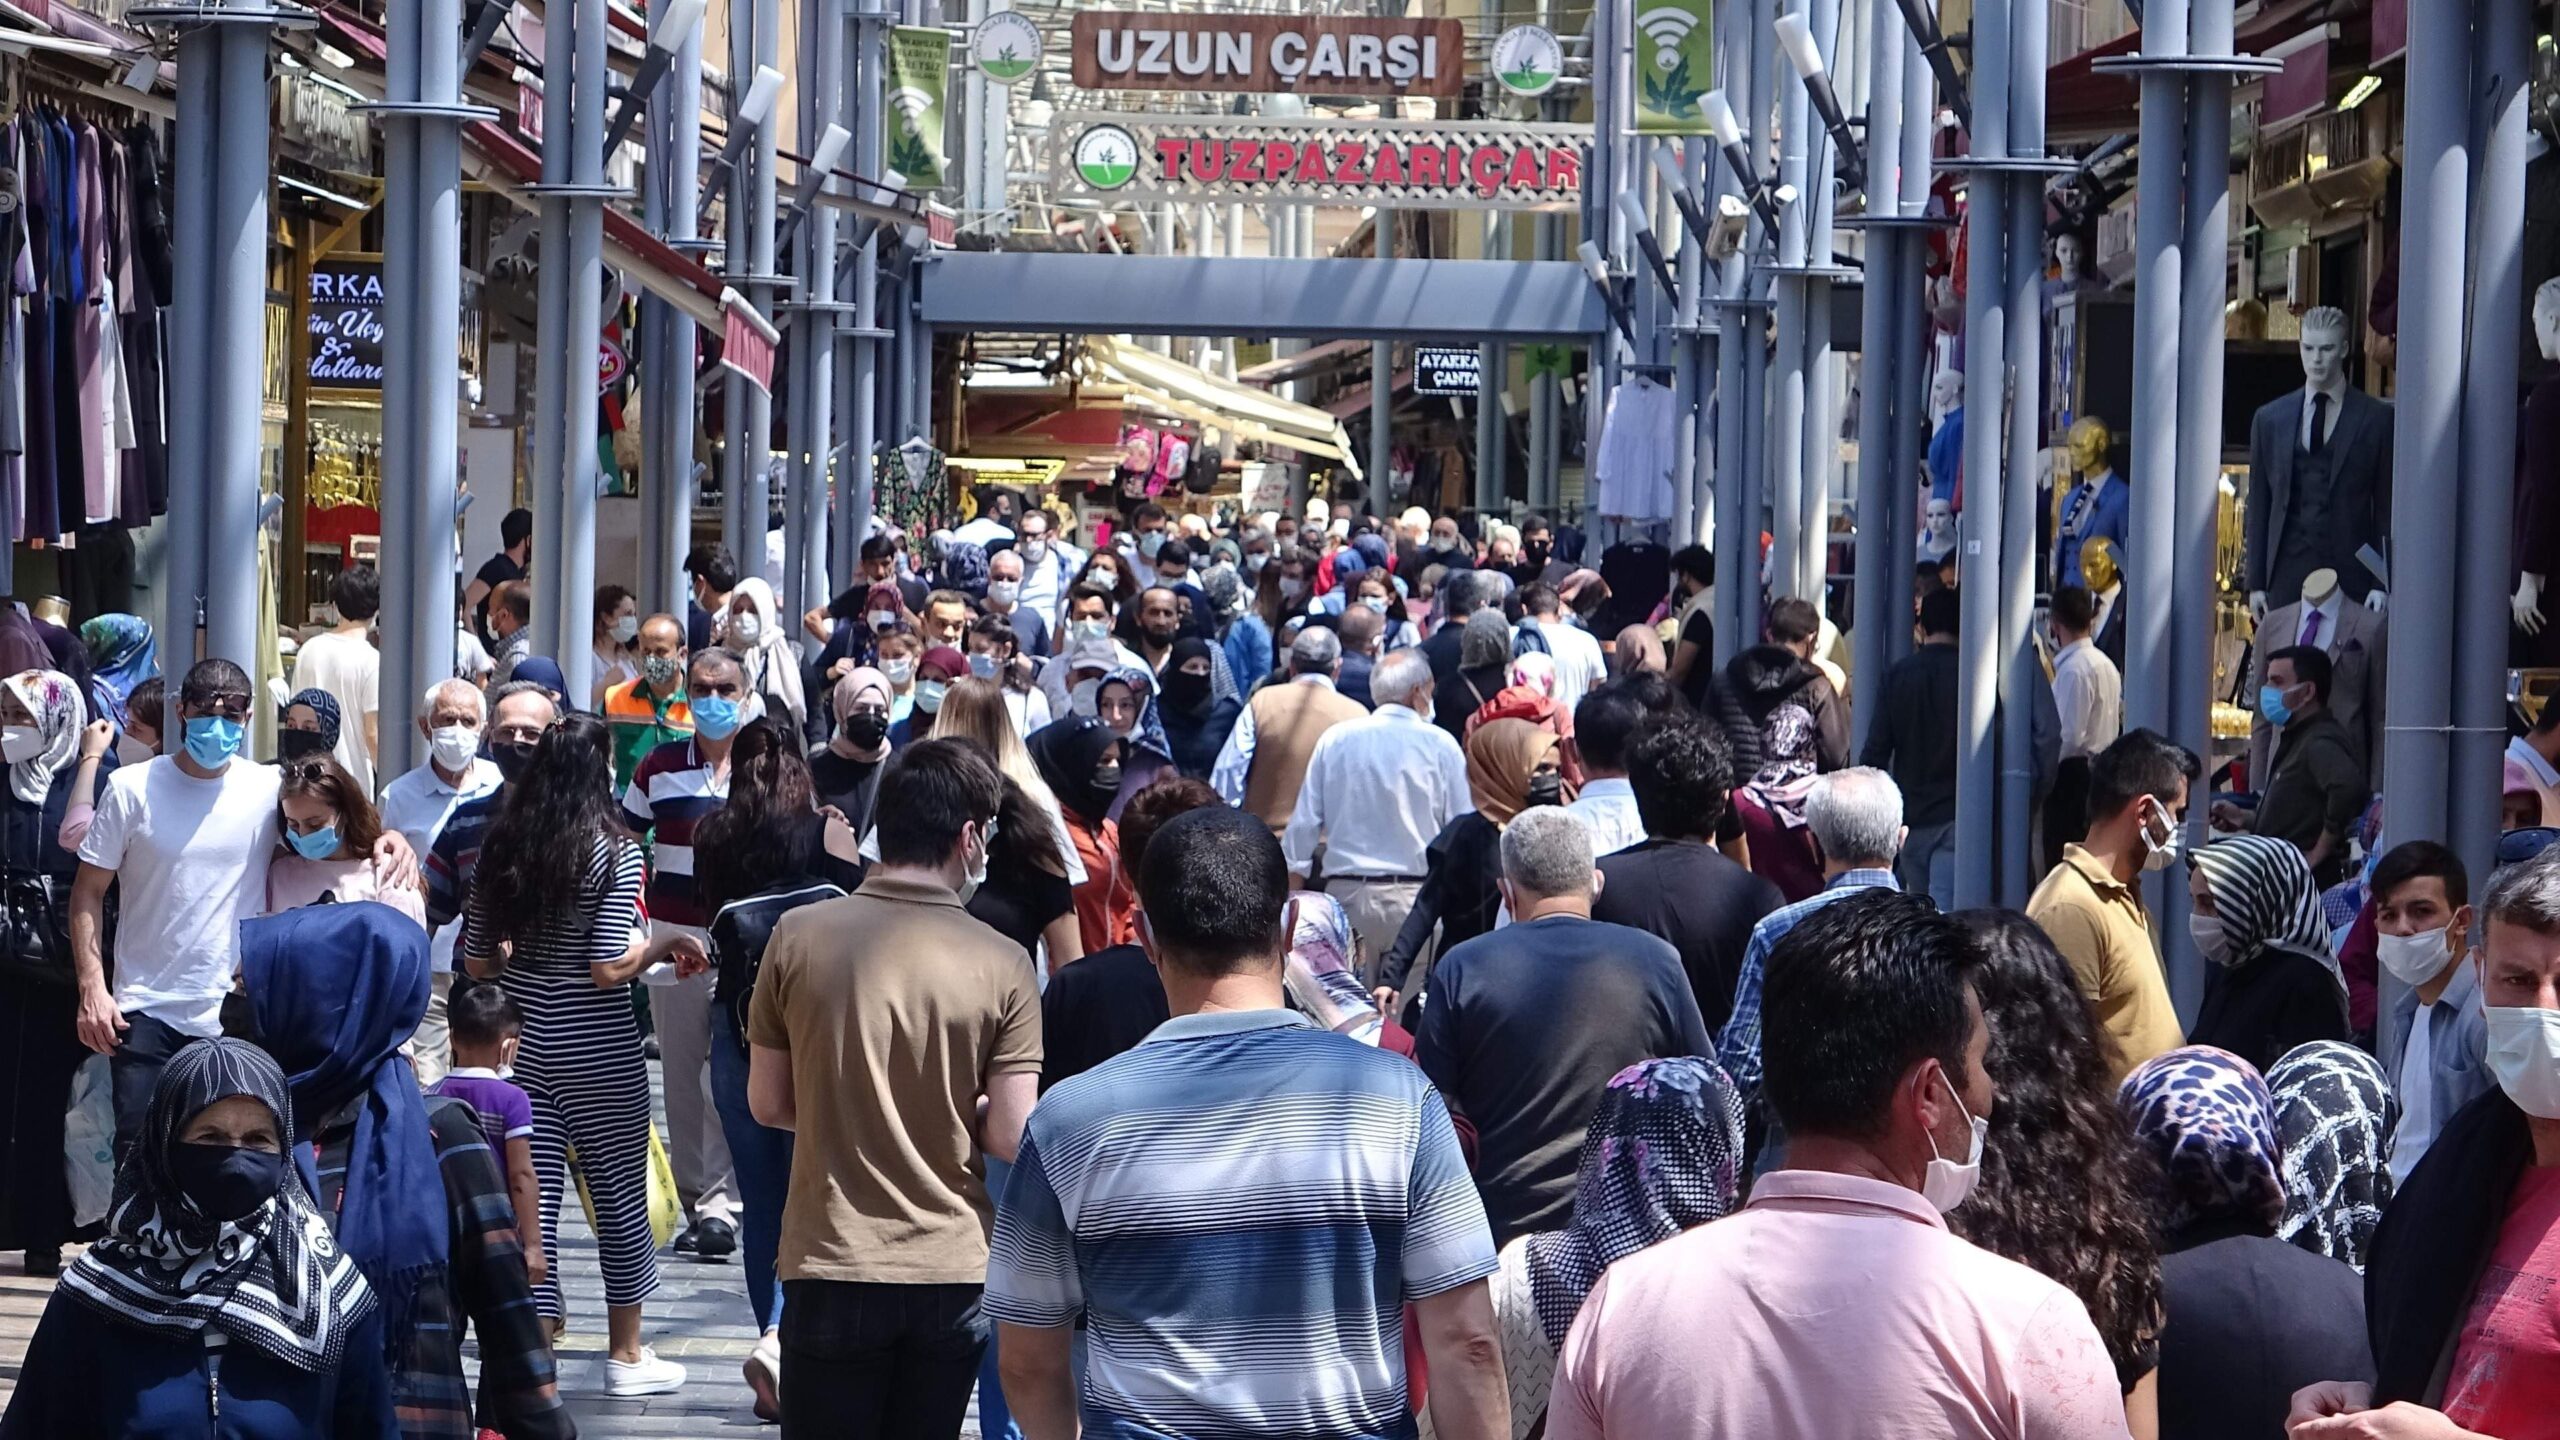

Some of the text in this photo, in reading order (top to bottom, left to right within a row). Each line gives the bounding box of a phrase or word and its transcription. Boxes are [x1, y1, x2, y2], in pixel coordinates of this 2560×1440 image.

[1097, 28, 1437, 87] UZUN ÇARŞI
[320, 336, 352, 357] &
[1421, 354, 1480, 370] AYAKKA
[1432, 370, 1480, 388] ÇANTA
